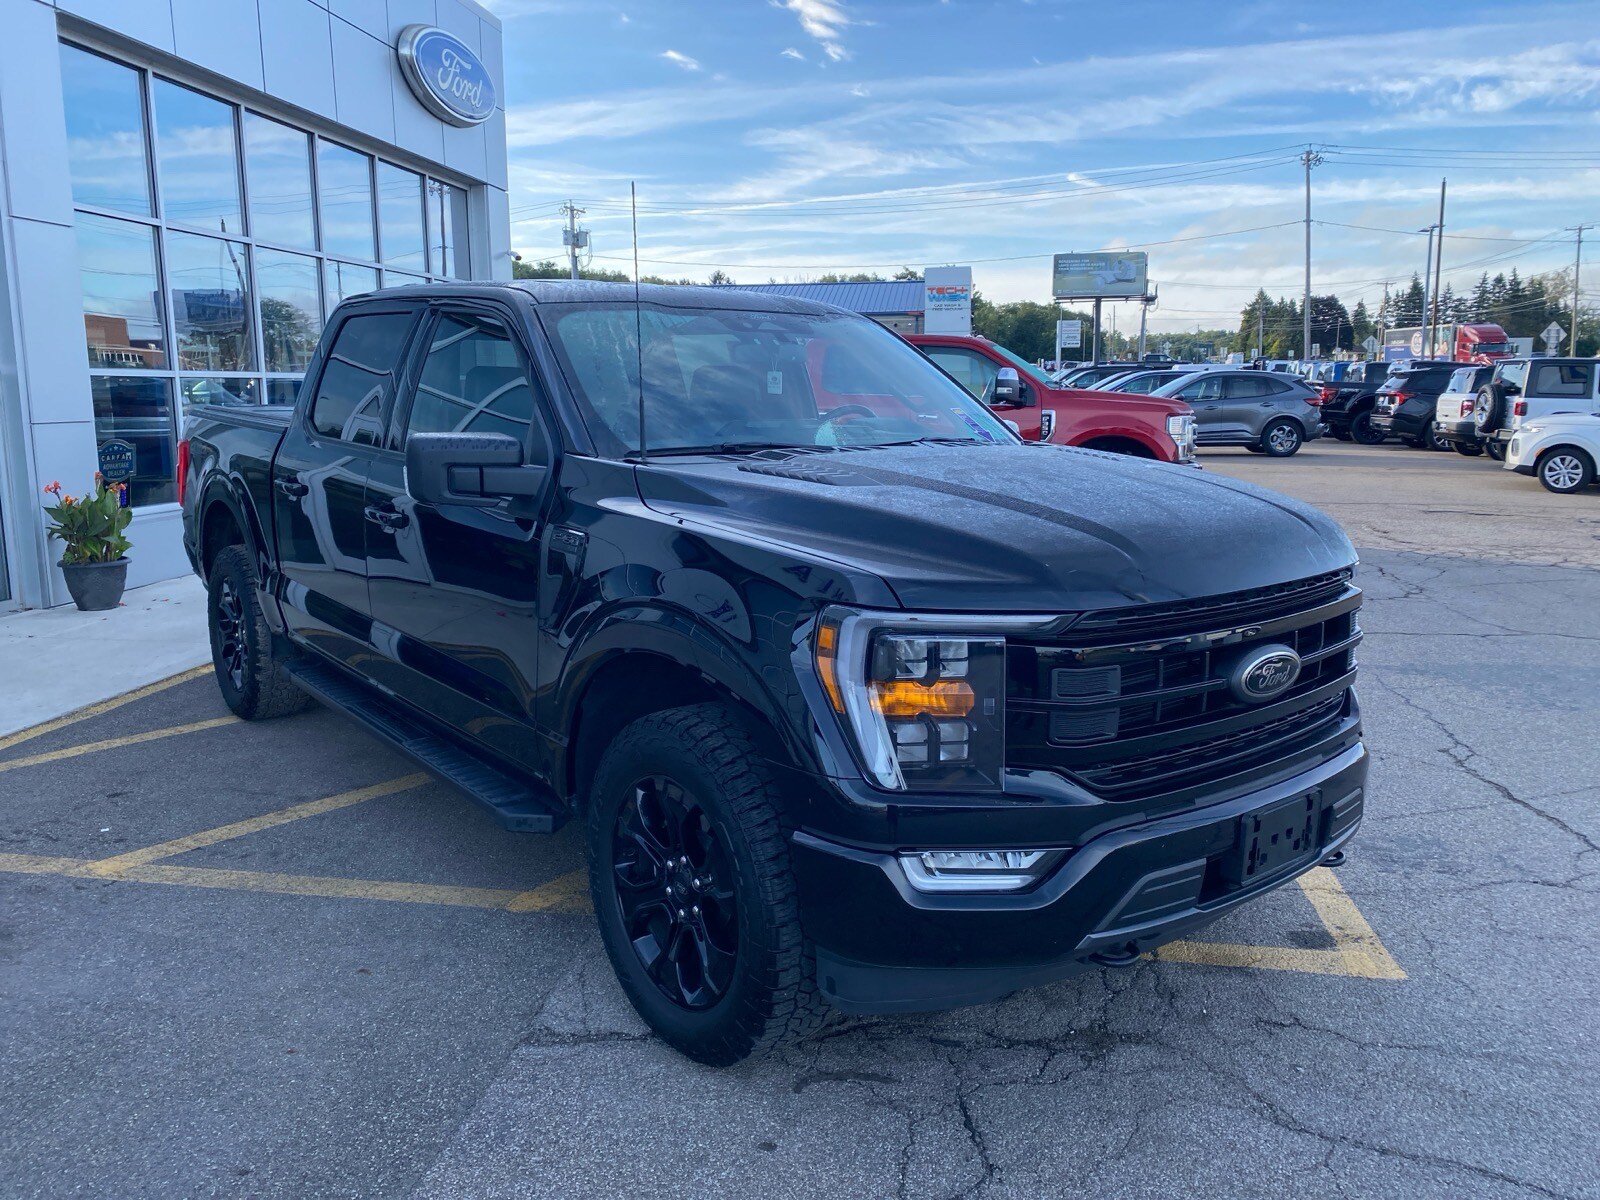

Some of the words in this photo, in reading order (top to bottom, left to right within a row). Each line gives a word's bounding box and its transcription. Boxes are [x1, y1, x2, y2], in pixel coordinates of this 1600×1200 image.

[438, 48, 483, 108] Ford
[101, 452, 132, 462] CARFAX
[103, 462, 129, 470] ADVANTAGE
[1258, 662, 1290, 688] Ford
